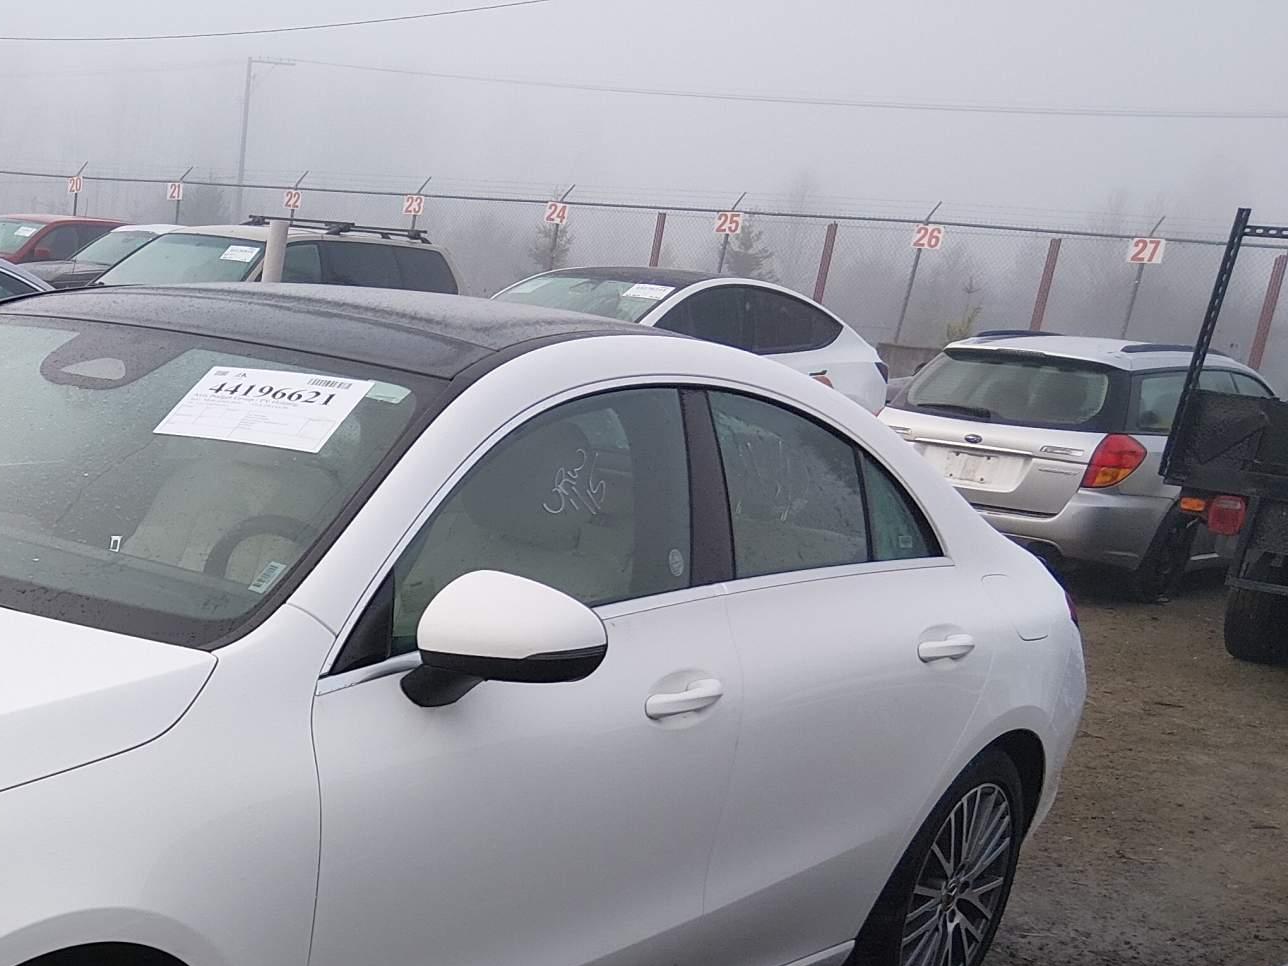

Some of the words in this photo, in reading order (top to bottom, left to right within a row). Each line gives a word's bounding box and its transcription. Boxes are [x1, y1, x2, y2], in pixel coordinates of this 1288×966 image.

[69, 177, 82, 192] 20
[169, 183, 181, 199] 21
[284, 191, 301, 208] 22
[405, 196, 424, 214] 23
[545, 203, 567, 223] 24
[715, 213, 740, 233] 25
[914, 226, 941, 248] 26
[1130, 239, 1161, 262] 27
[208, 382, 336, 406] 44196621
